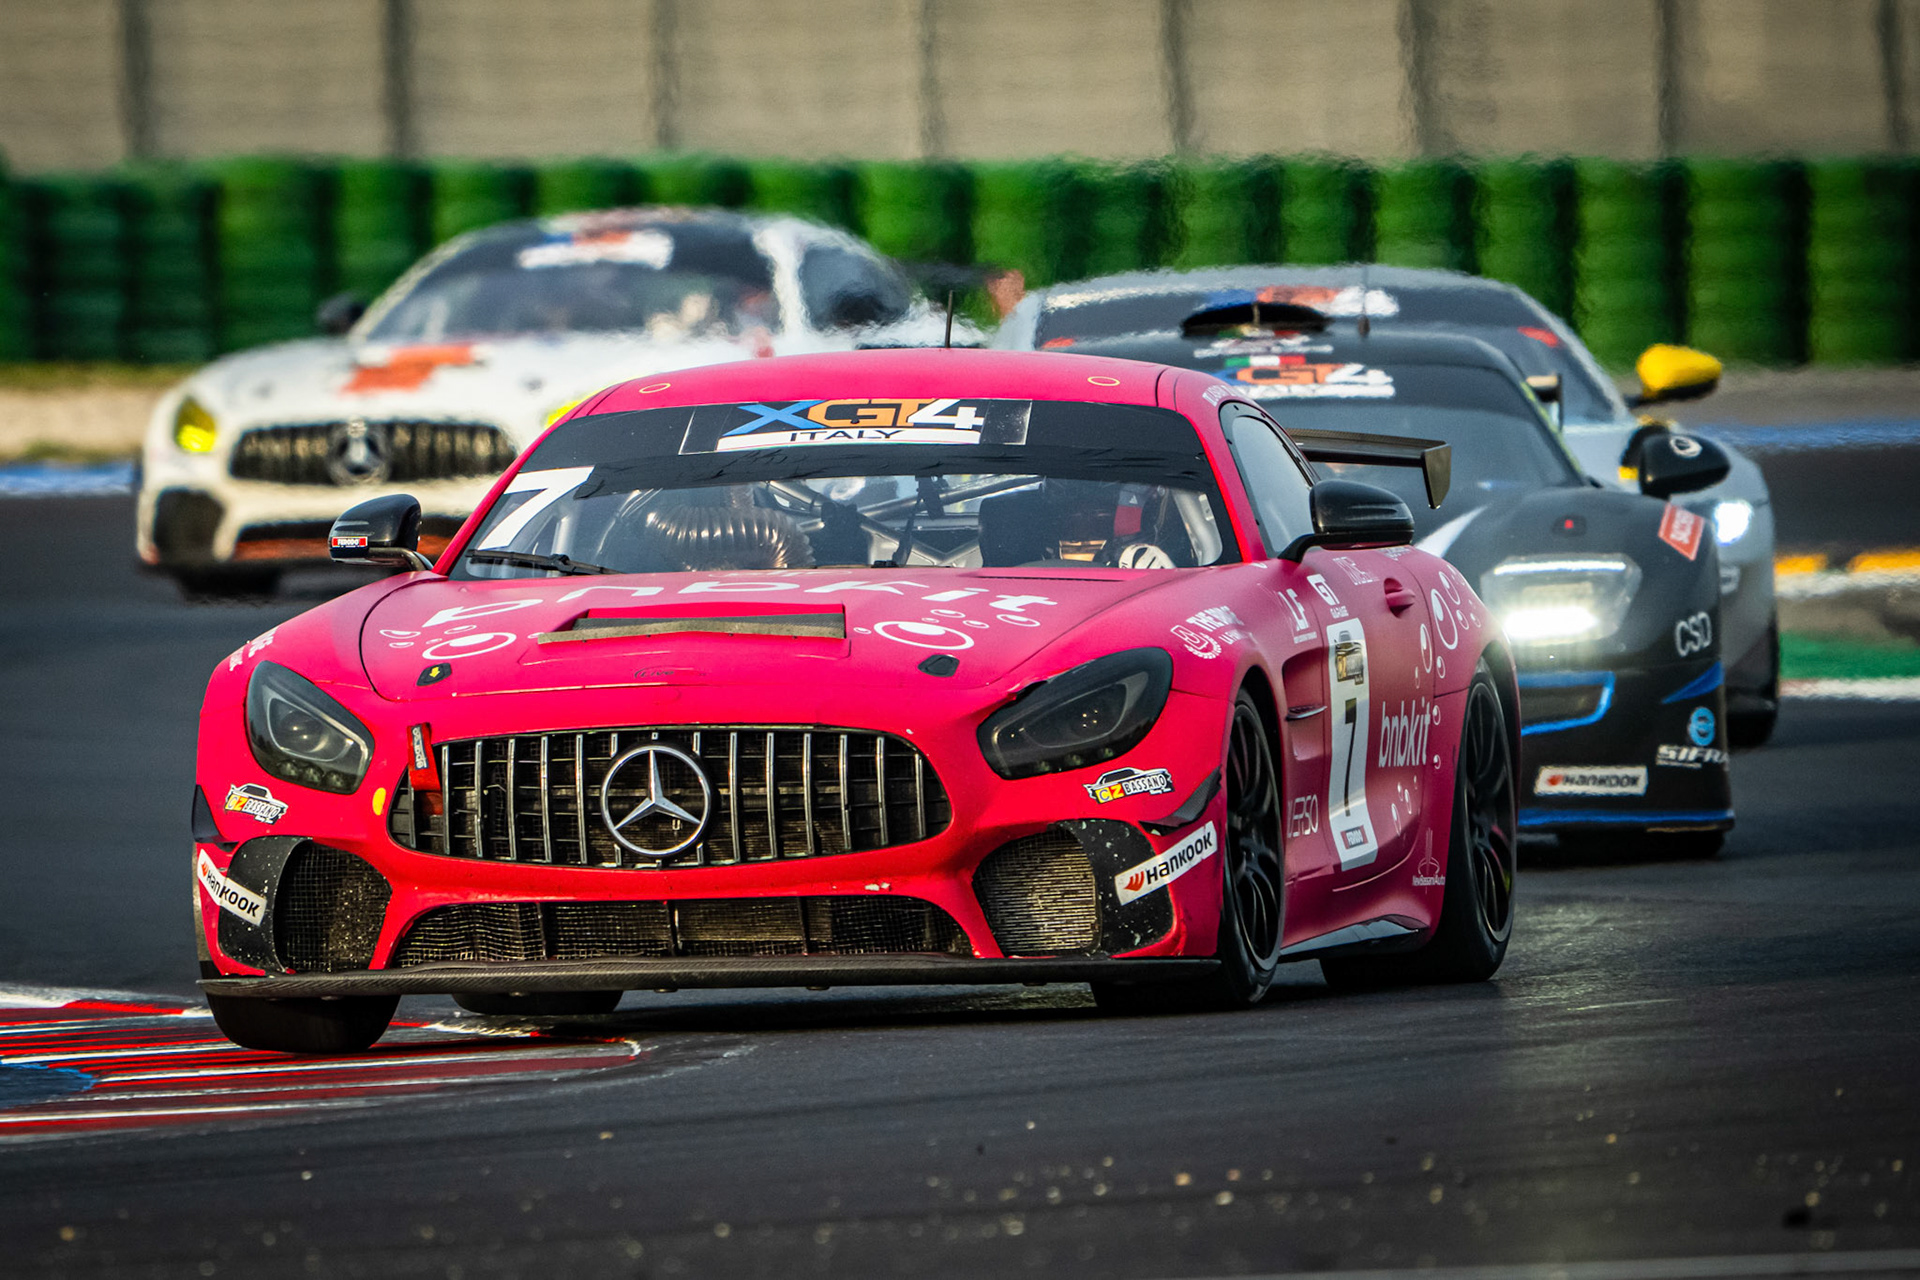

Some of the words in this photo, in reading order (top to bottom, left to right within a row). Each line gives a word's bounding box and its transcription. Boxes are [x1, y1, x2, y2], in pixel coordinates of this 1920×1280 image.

[722, 398, 985, 436] XGT4
[789, 429, 905, 442] ITALY
[477, 466, 595, 551] 7
[1378, 697, 1431, 768] bnbkit
[1344, 697, 1357, 817] 7
[1125, 775, 1167, 794] BASSANO
[243, 800, 281, 819] BASSANO
